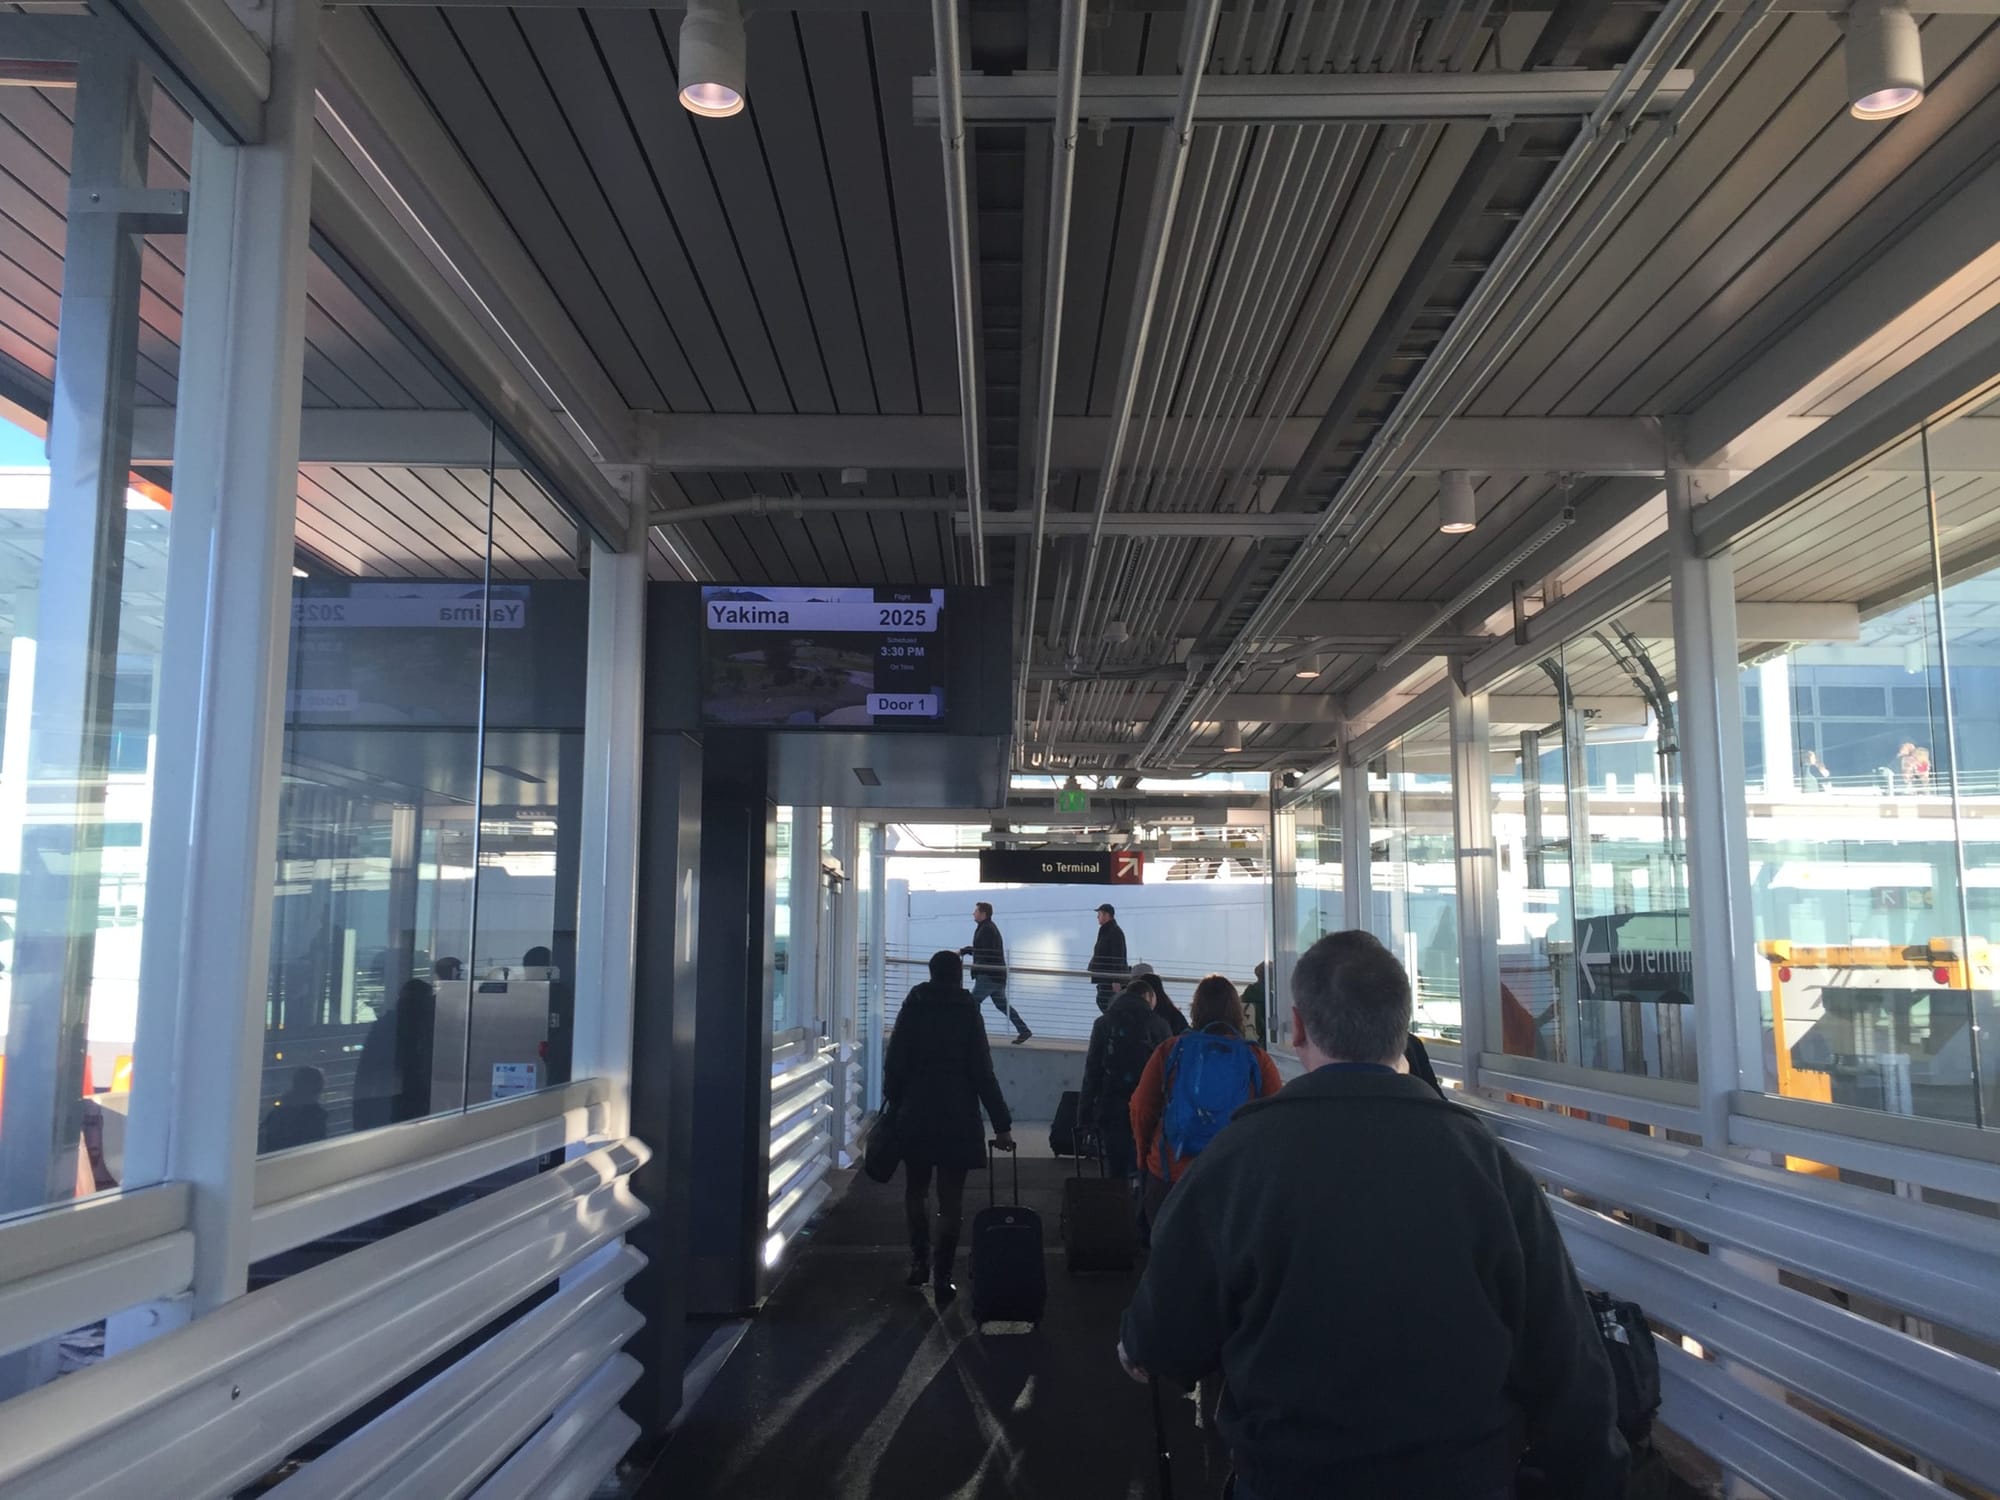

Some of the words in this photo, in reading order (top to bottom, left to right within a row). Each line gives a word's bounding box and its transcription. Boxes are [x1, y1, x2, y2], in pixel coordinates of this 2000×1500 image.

[712, 605, 790, 625] Yakima
[879, 609, 926, 626] 2025
[880, 646, 904, 657] 3:30
[907, 646, 925, 657] PM
[878, 698, 913, 711] Door
[917, 699, 925, 711] 1
[1041, 863, 1053, 873] to
[1056, 862, 1100, 873] Terminal
[683, 868, 693, 963] 1
